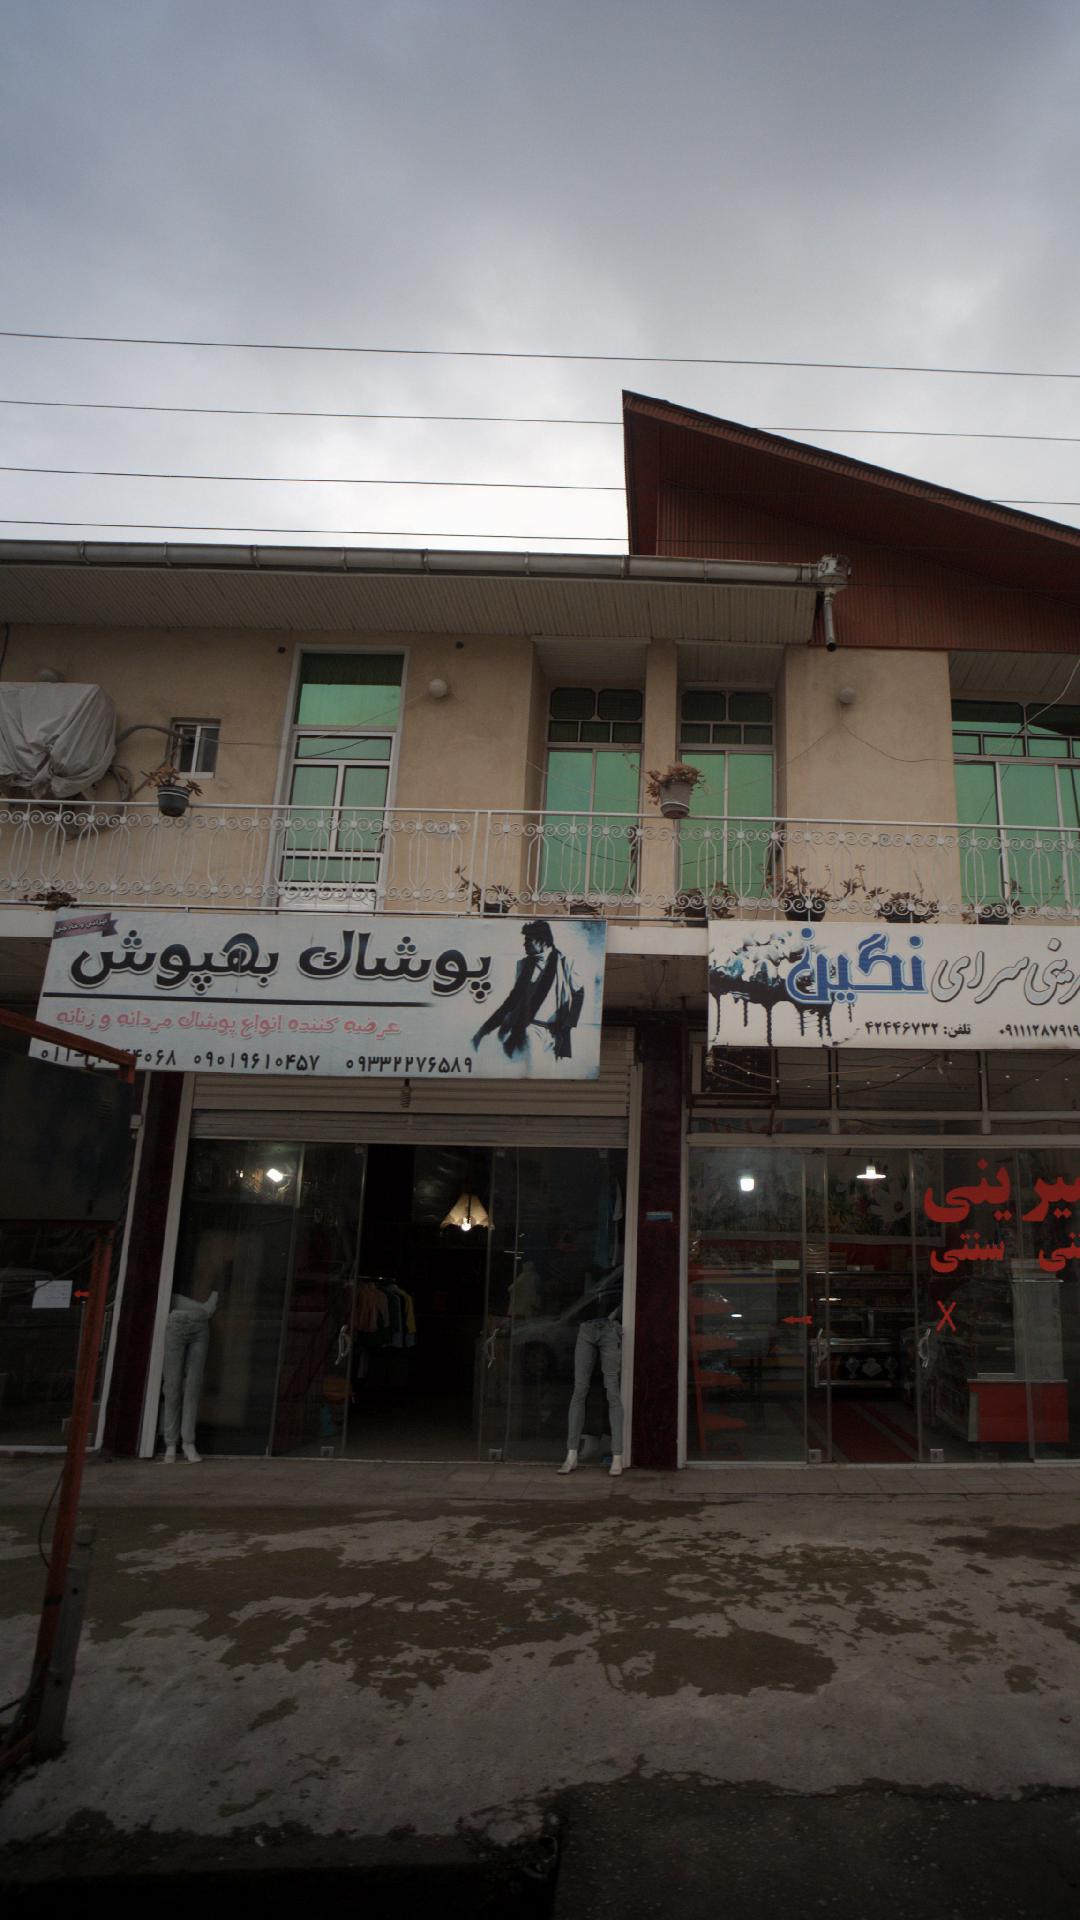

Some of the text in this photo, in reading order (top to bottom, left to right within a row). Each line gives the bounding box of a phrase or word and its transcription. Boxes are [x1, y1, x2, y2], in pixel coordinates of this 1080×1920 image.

[68, 929, 280, 994] بهپوش
[785, 927, 928, 1005] نگین
[930, 949, 1030, 1005] سرای
[56, 1008, 97, 1030] زنانه
[98, 1014, 111, 1031] و
[117, 1011, 173, 1033] مردانه
[240, 1013, 282, 1040] انواع
[287, 1016, 341, 1034] کننده
[343, 1019, 402, 1041] عرضه
[865, 1021, 939, 1036] ۴۲۴۴۶۷۳۲
[943, 1023, 972, 1038] تلفن:
[193, 1051, 320, 1072] ۰۹۰۱۹۶۱۰۴۵۷
[346, 1056, 473, 1074] ۰۹۳۳۲۲۷۶۵۸۹
[930, 1231, 1006, 1273] سنتی
